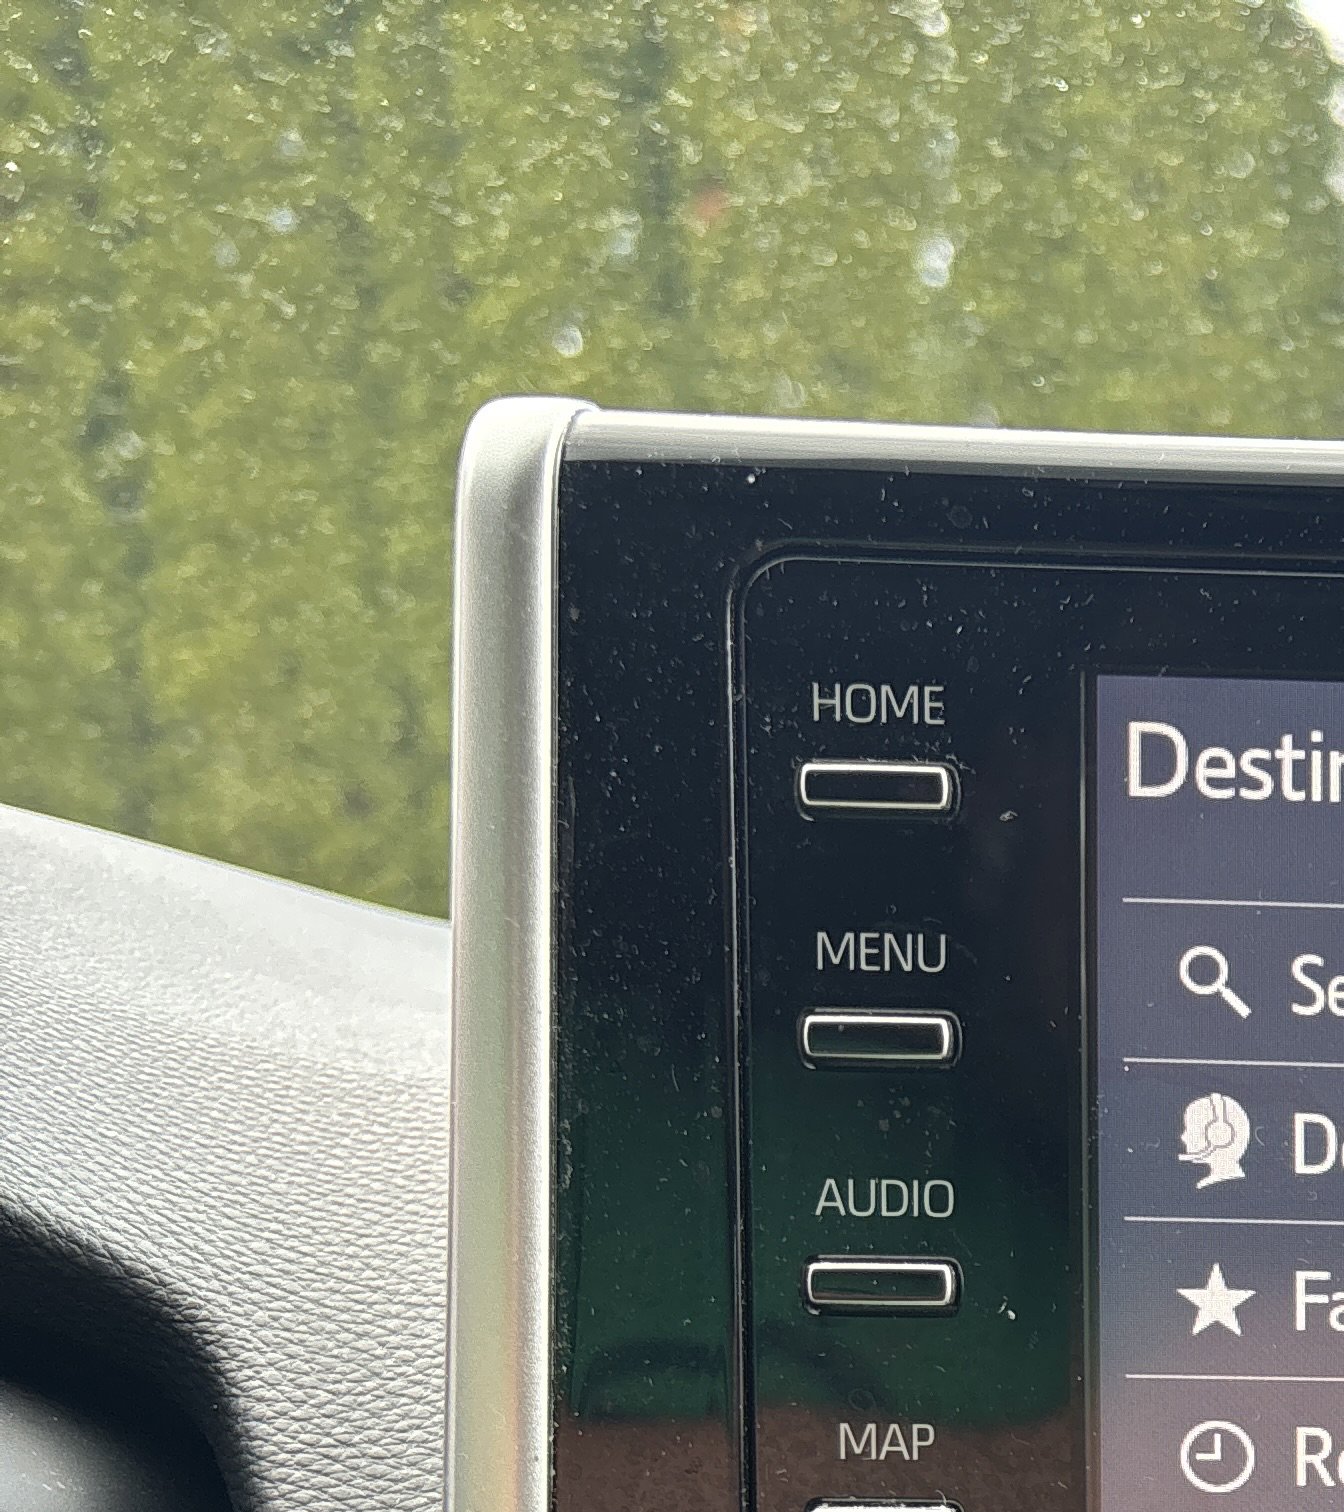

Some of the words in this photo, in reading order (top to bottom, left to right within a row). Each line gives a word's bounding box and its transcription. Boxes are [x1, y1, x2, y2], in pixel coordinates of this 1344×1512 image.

[813, 683, 944, 724] HOME
[817, 932, 945, 972] MENU
[815, 1179, 953, 1217] AUDIO
[840, 1423, 934, 1460] MAP
